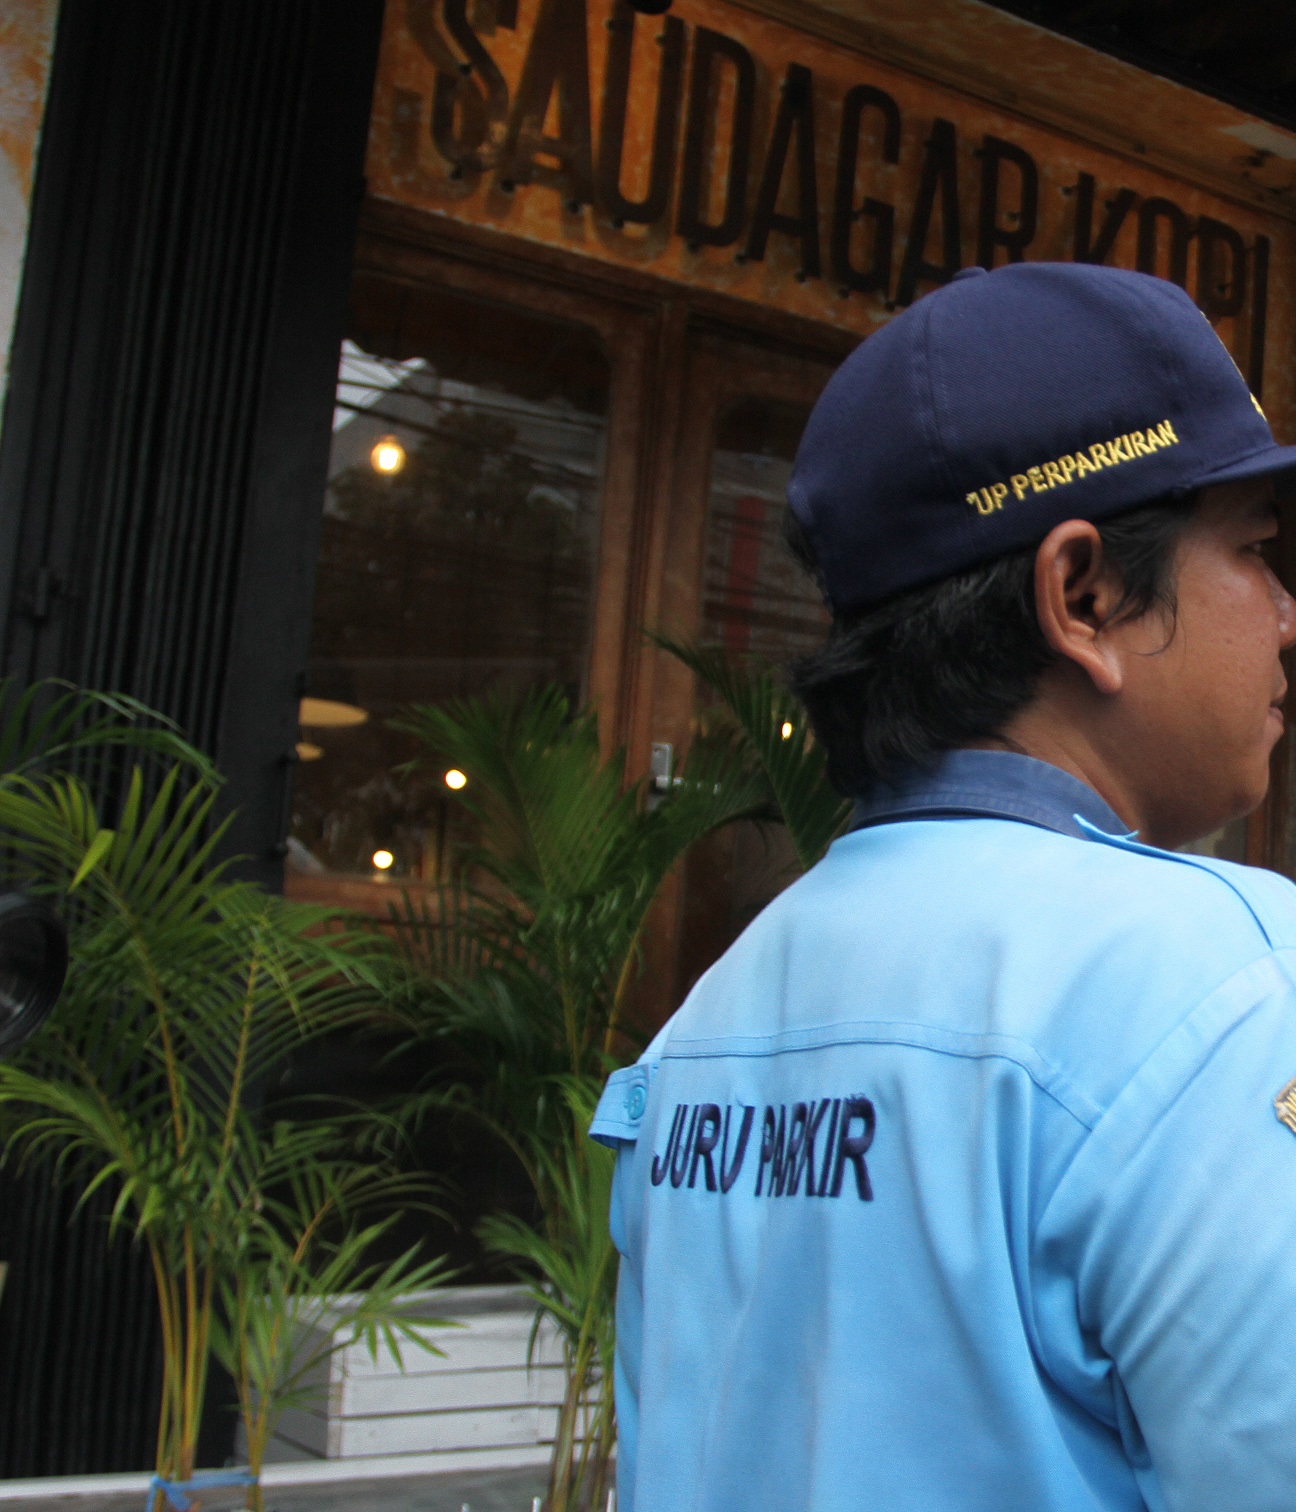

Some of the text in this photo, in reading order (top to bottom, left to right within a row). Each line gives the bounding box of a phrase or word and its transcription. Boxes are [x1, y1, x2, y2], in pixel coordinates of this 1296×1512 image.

[427, 0, 1039, 306] SAUDAGAR
[966, 419, 1179, 515] UP PERPARKIRAN
[651, 1095, 876, 1201] JURU PARKIR
